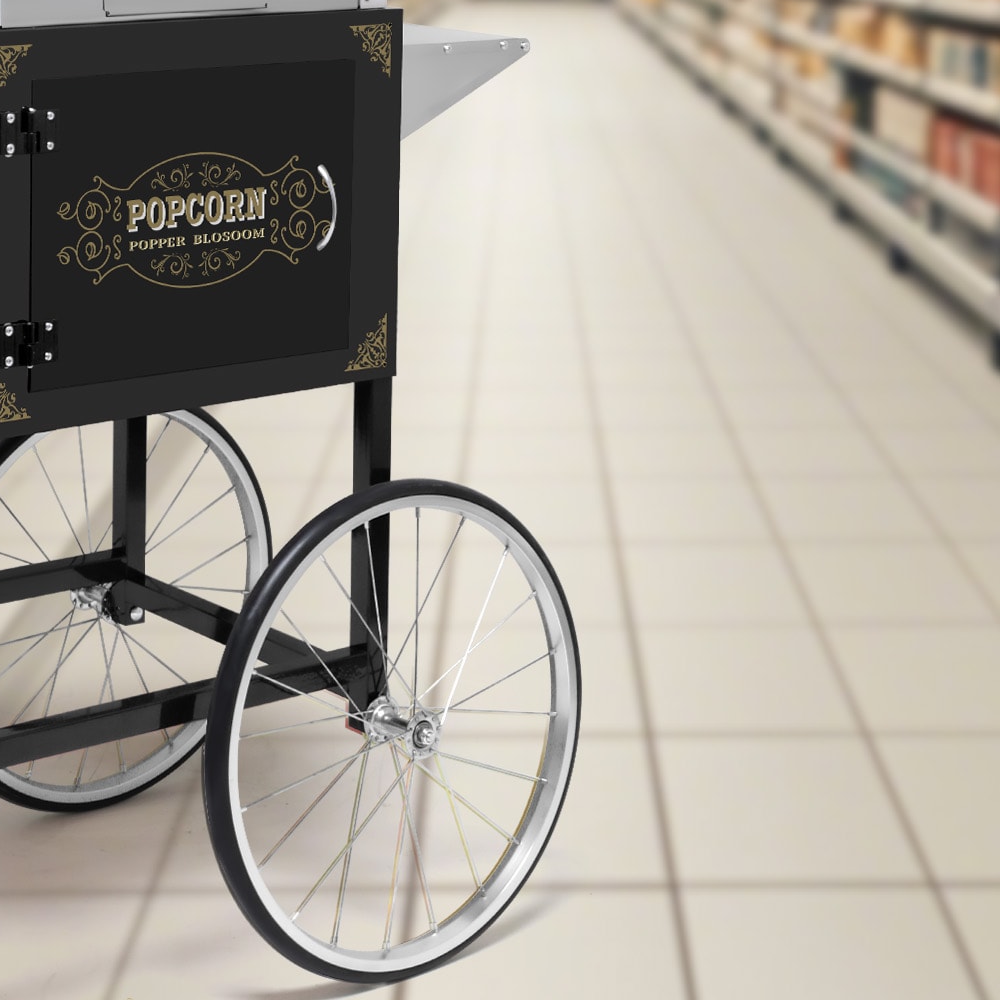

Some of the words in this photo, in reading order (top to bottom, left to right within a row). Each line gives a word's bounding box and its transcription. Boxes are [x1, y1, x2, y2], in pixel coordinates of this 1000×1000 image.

[126, 187, 267, 233] POPCORN
[129, 236, 186, 251] POPPER
[193, 228, 265, 245] BLOSOOM
